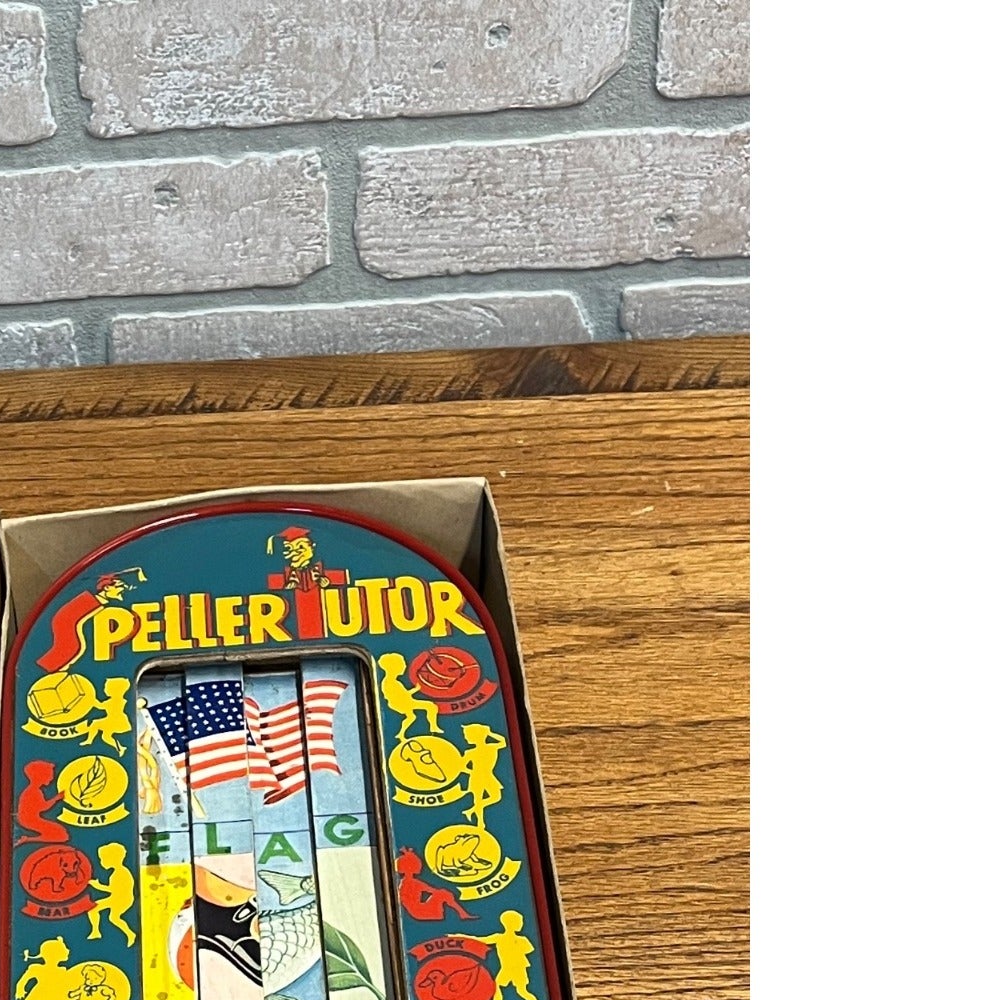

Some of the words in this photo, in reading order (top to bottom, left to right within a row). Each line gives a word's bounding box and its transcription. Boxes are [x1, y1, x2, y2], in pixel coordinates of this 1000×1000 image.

[36, 590, 295, 673] SPELLER
[267, 568, 486, 639] TUTOR
[450, 691, 486, 712] DRUM
[39, 726, 79, 737] BOOK
[408, 794, 444, 805] SHOE
[77, 814, 107, 825] LEAF
[476, 873, 510, 896] FROG
[424, 939, 465, 953] DUCK
